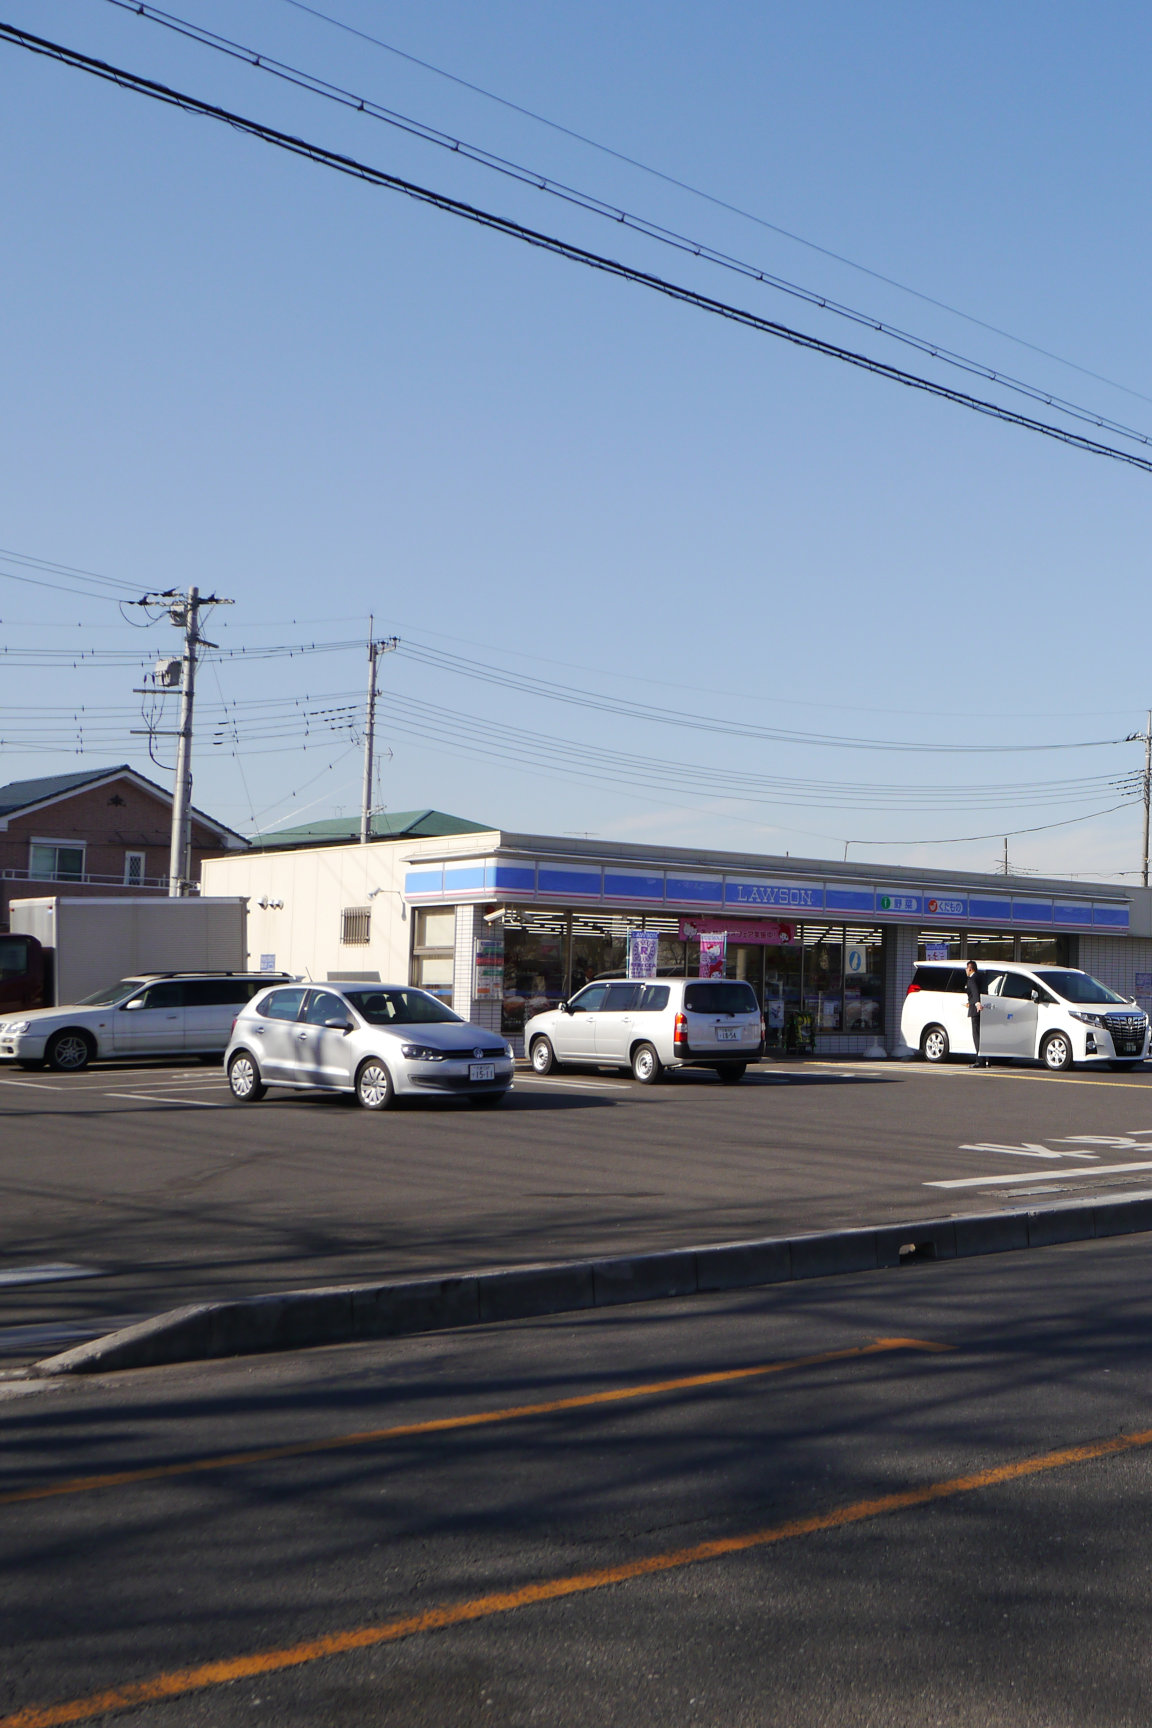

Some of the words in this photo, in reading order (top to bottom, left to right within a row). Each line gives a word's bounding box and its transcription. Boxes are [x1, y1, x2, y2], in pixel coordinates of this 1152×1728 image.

[737, 886, 813, 905] LAWSON
[893, 898, 913, 910] 野菜
[938, 901, 962, 913] くだもの
